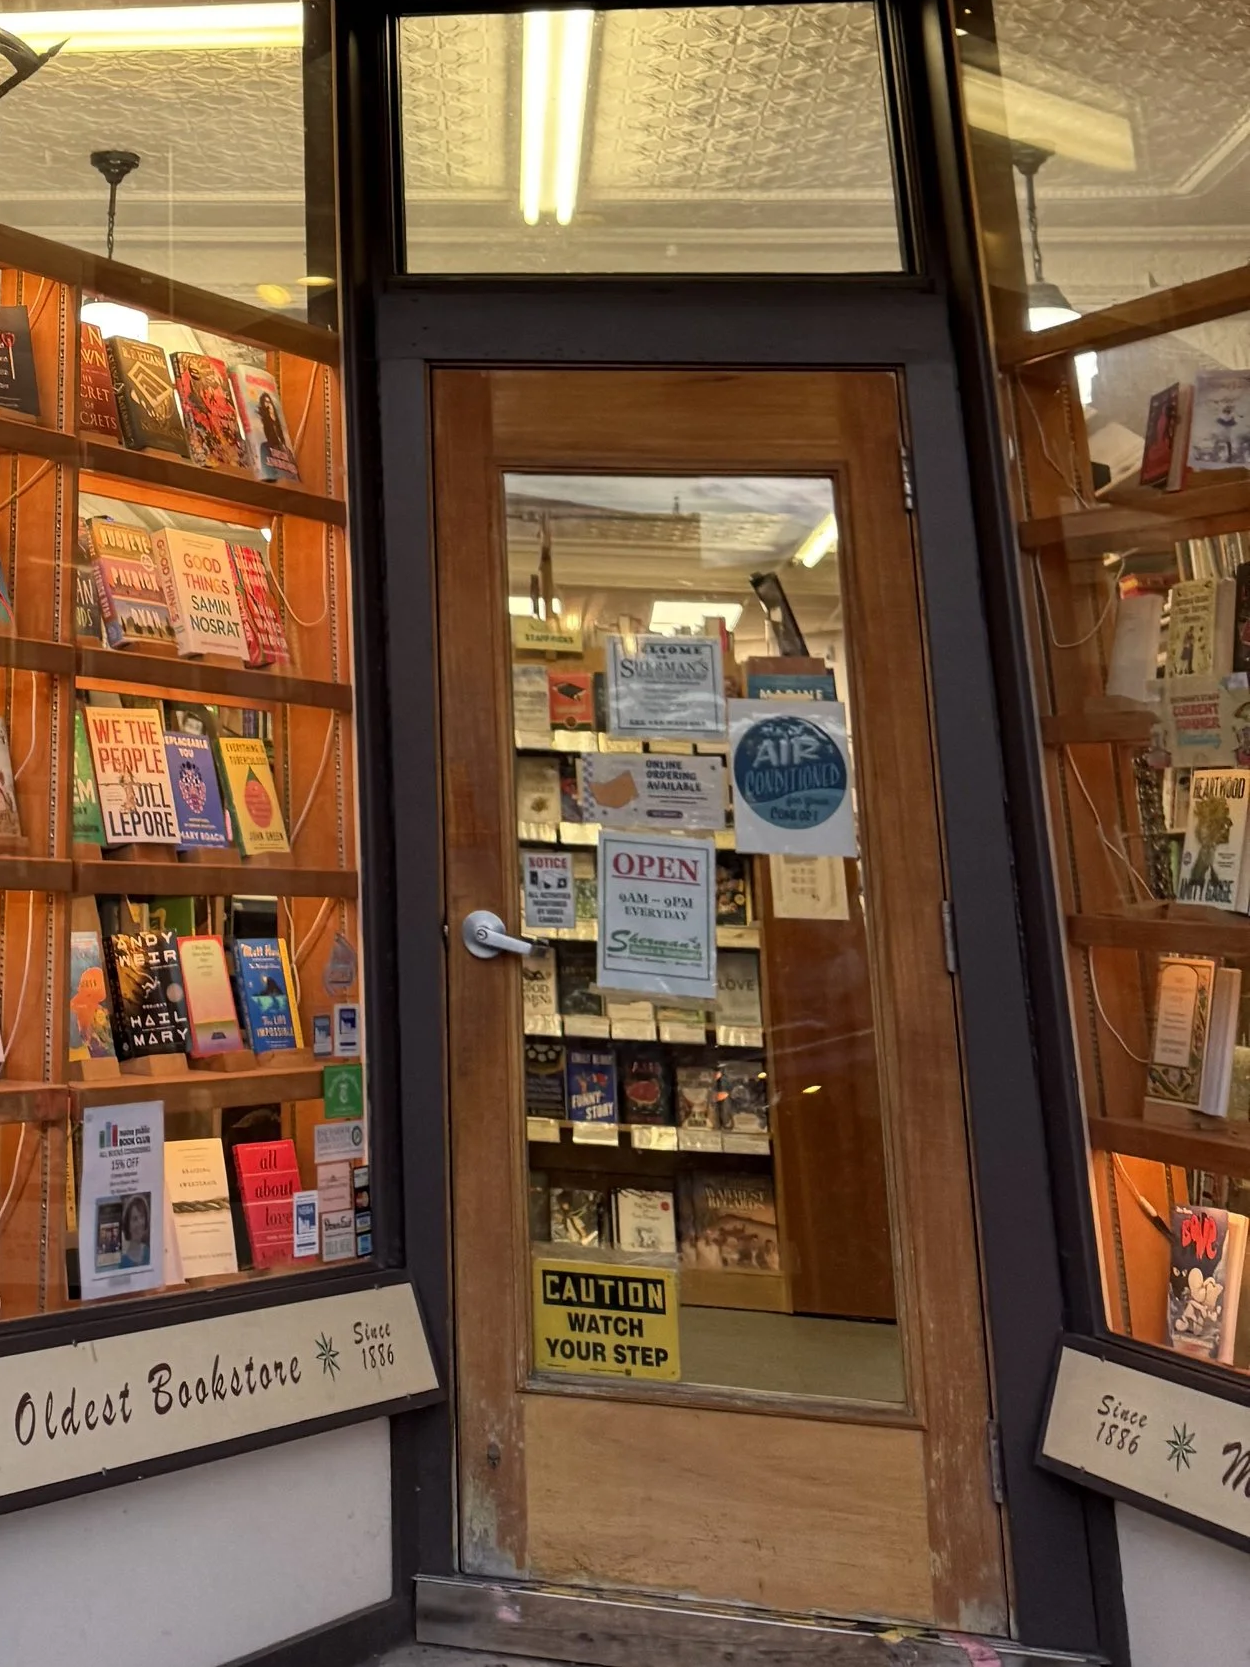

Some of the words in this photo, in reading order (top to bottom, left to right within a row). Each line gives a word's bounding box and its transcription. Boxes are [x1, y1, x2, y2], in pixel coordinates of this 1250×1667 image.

[183, 552, 222, 575] GOOD
[110, 567, 160, 592] PATRICK
[183, 572, 230, 595] THINGS
[190, 595, 232, 618] SAMIN
[189, 614, 241, 639] NOSRAT
[92, 719, 121, 745] WE
[124, 721, 160, 746] THE
[97, 747, 165, 775] PEOPLE
[178, 747, 194, 758] YOU
[752, 733, 821, 768] AIR
[646, 759, 682, 770] ONLINE
[646, 770, 697, 781] ORDERING
[647, 781, 702, 792] AVAILABLE
[744, 761, 841, 796] CONDITIONED
[1193, 776, 1246, 799] HEARTWOOD
[134, 782, 171, 809] JILL
[108, 811, 177, 838] LEPORE
[529, 856, 567, 870] NOTICE
[612, 852, 699, 883] OPEN
[619, 892, 648, 904] 9AM
[663, 897, 693, 909] 9PM
[624, 905, 688, 921] EVERYDAY
[116, 931, 173, 950] ANDY
[118, 949, 177, 968] WEIR
[130, 1010, 187, 1028] HAIL
[133, 1027, 188, 1047] MARY
[119, 1137, 135, 1146] BOOK
[136, 1135, 151, 1144] CLUB
[111, 1159, 125, 1171] 15%
[126, 1157, 139, 1169] OFF
[260, 1149, 278, 1170] all
[255, 1179, 293, 1199] about
[545, 1274, 664, 1310] CAUTION
[352, 1320, 393, 1346] Since
[567, 1312, 644, 1338] WATCH
[361, 1343, 396, 1371] 1886
[545, 1337, 607, 1362] YOUR
[613, 1343, 669, 1367] STEP
[13, 1385, 134, 1448] Oldest
[147, 1352, 303, 1419] Bookstore
[1097, 1394, 1148, 1429] Since
[1095, 1421, 1142, 1456] 1886
